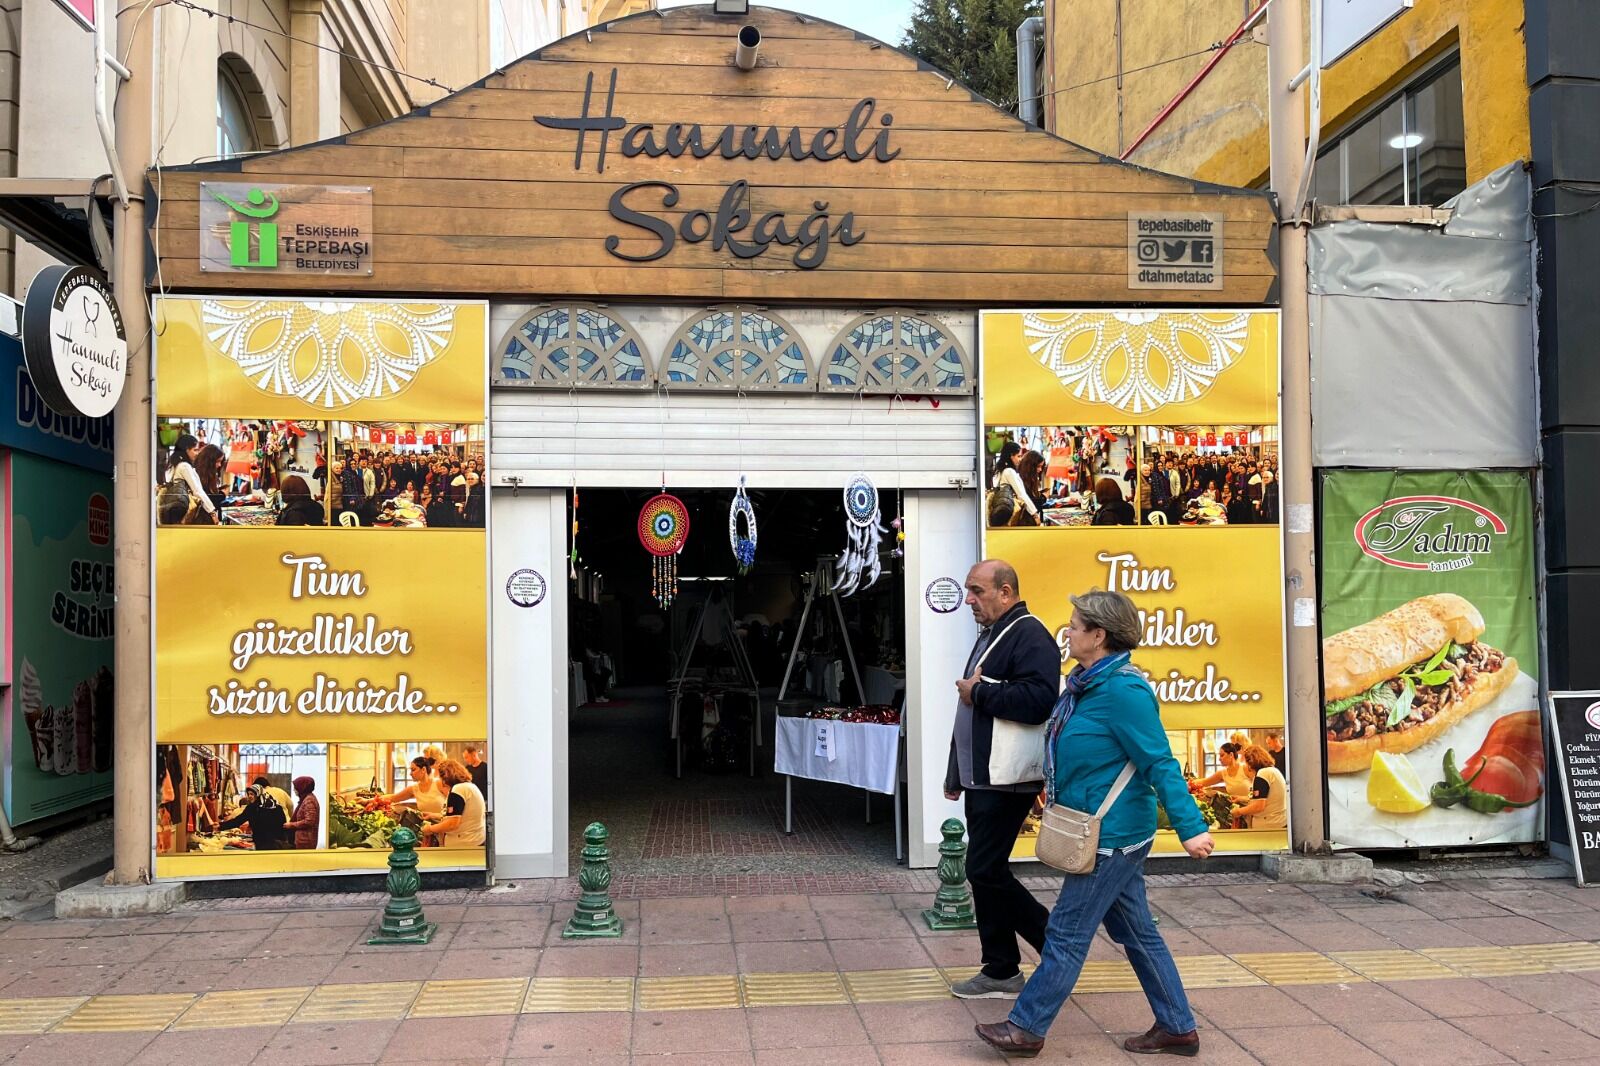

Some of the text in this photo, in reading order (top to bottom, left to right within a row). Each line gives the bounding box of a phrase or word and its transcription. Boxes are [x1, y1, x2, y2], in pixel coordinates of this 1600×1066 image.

[533, 67, 902, 174] Hanımeli
[296, 224, 359, 239] ESKİŞEHİR
[605, 178, 866, 270] Sokağı
[1138, 218, 1214, 233] tepebasibeltr
[281, 236, 369, 258] TEPEBAŞI
[296, 257, 360, 270] BELEDİYESİ
[1138, 270, 1214, 283] dtahmetatac
[70, 361, 112, 398] Sokağı
[88, 519, 110, 537] KING
[1368, 506, 1491, 554] Tadım
[282, 554, 366, 598] Tüm
[1098, 552, 1174, 592] Tüm
[1430, 554, 1474, 572] tantuni
[70, 560, 103, 602] SEÇ
[232, 616, 413, 671] güzellikler
[209, 674, 459, 715] sizin elinizde...
[1569, 755, 1597, 764] Ekmek
[1570, 766, 1598, 776] Ekmek
